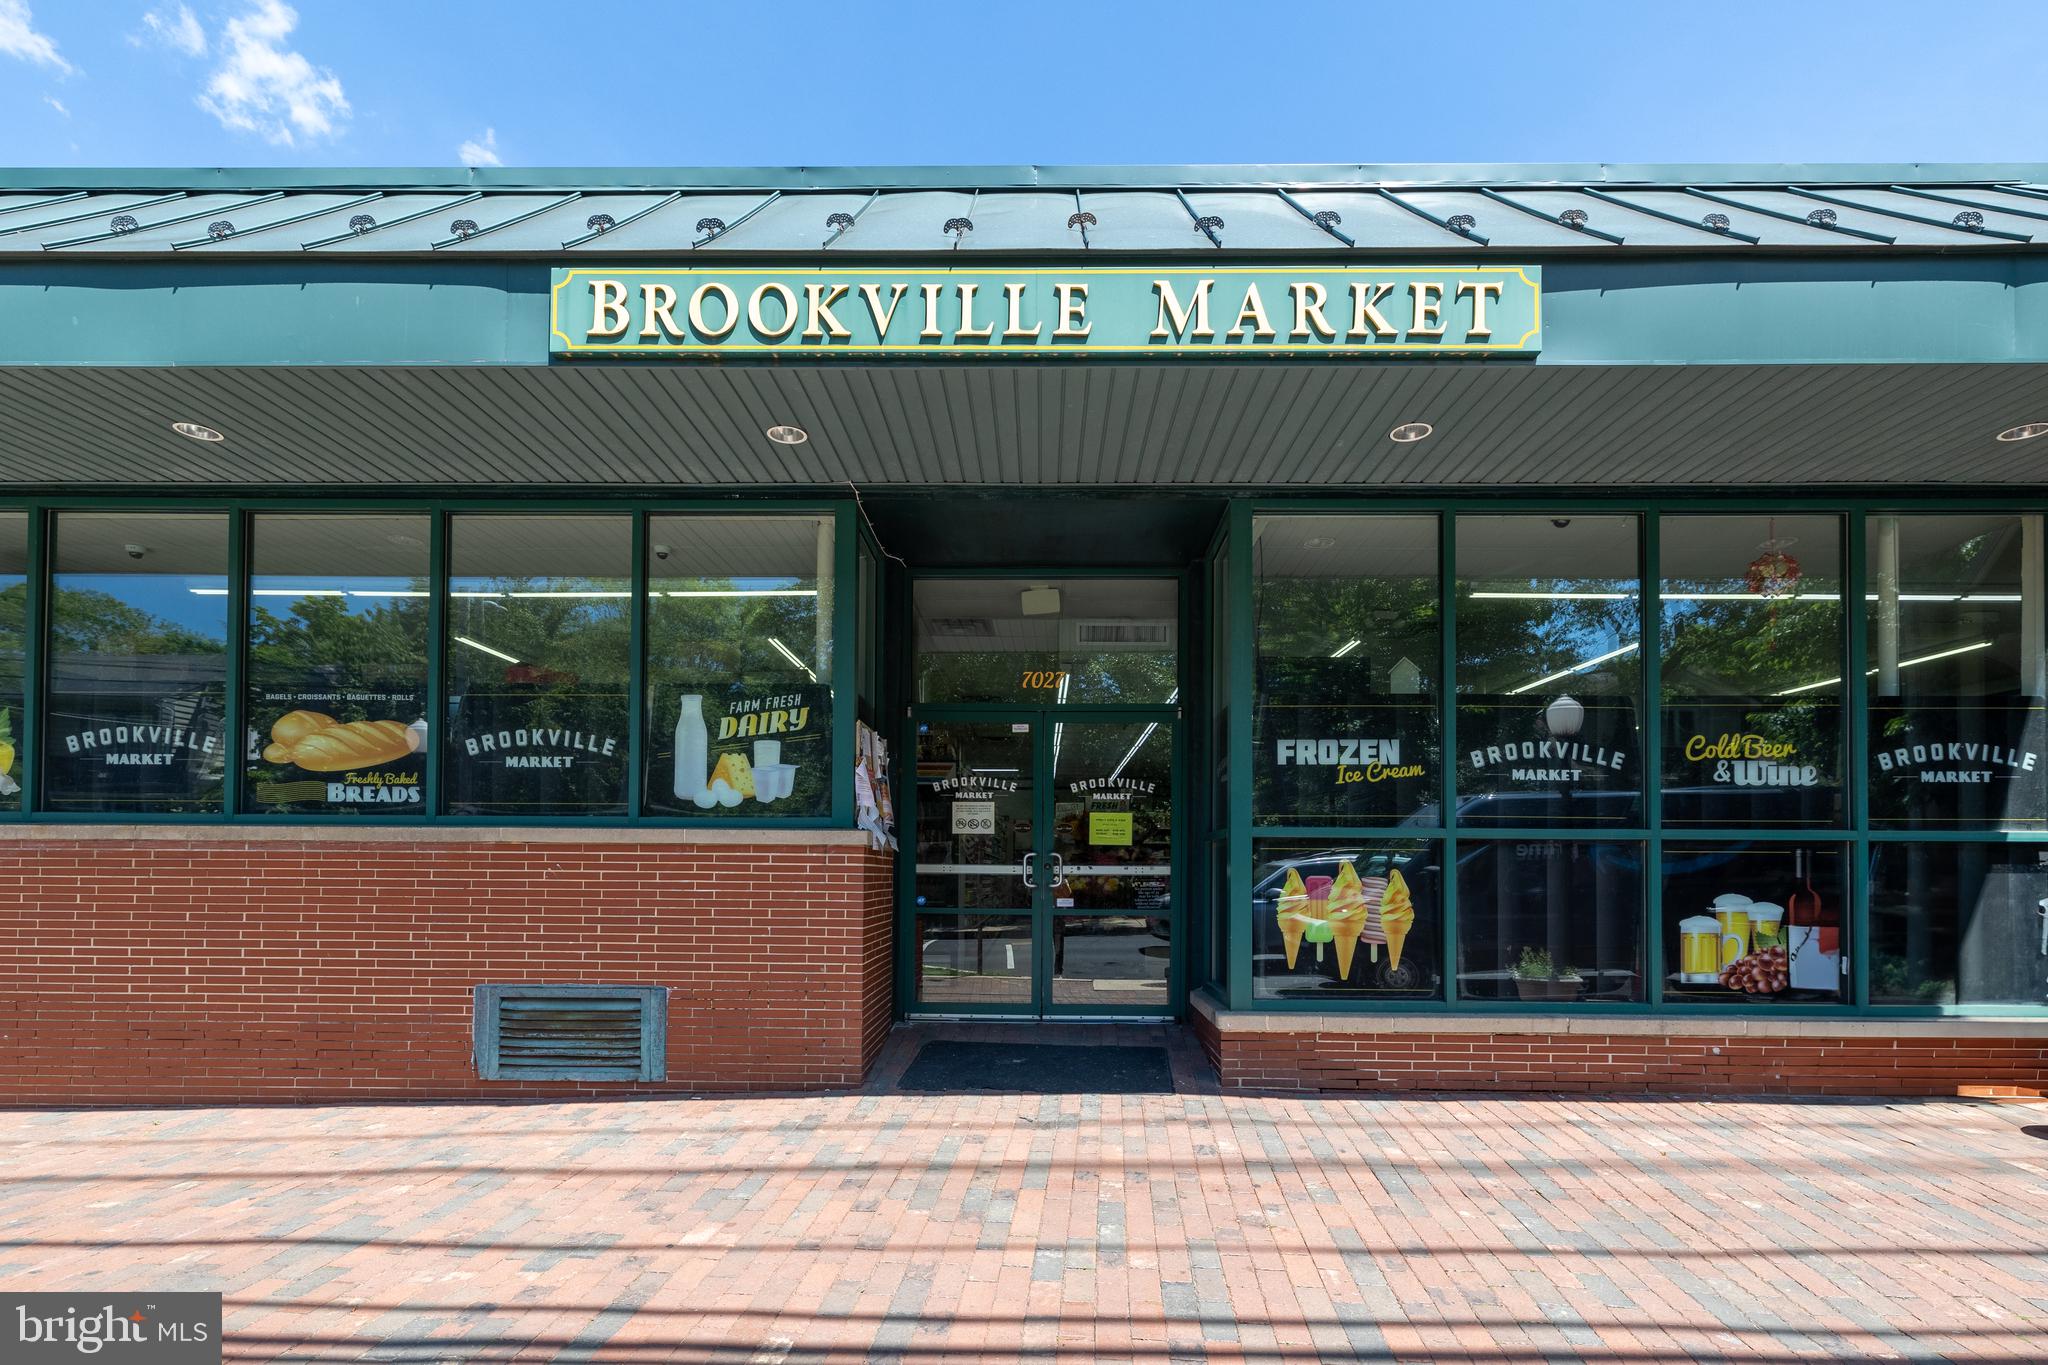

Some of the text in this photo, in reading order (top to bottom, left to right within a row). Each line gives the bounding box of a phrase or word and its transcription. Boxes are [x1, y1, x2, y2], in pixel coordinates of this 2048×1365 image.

[586, 279, 1504, 338] BROOKVILLE MARKET
[1022, 671, 1066, 688] 7027
[730, 693, 802, 712] FARM FRESH
[717, 706, 809, 740] DAIRY
[65, 726, 217, 753] BROOKVILLE
[465, 729, 616, 757] BROOKVILLE
[1685, 733, 1798, 761] Cold Beer
[106, 753, 175, 765] MARKET
[505, 756, 574, 768] MARKET
[1277, 739, 1400, 766] FROZEN
[1470, 740, 1625, 771] BROOKVILLE
[1877, 743, 2038, 771] BROOKVILLE
[344, 771, 418, 789] Freshly Baked
[1335, 761, 1426, 784] Ice Cream
[1512, 769, 1582, 781] MARKET
[1921, 771, 1993, 783] MARKET
[327, 782, 420, 803] BREADS
[933, 776, 1018, 793] BROOKVILLE
[1070, 777, 1156, 794] BROOKVILLE
[955, 792, 994, 800] MARKET
[1092, 793, 1132, 801] MARKET
